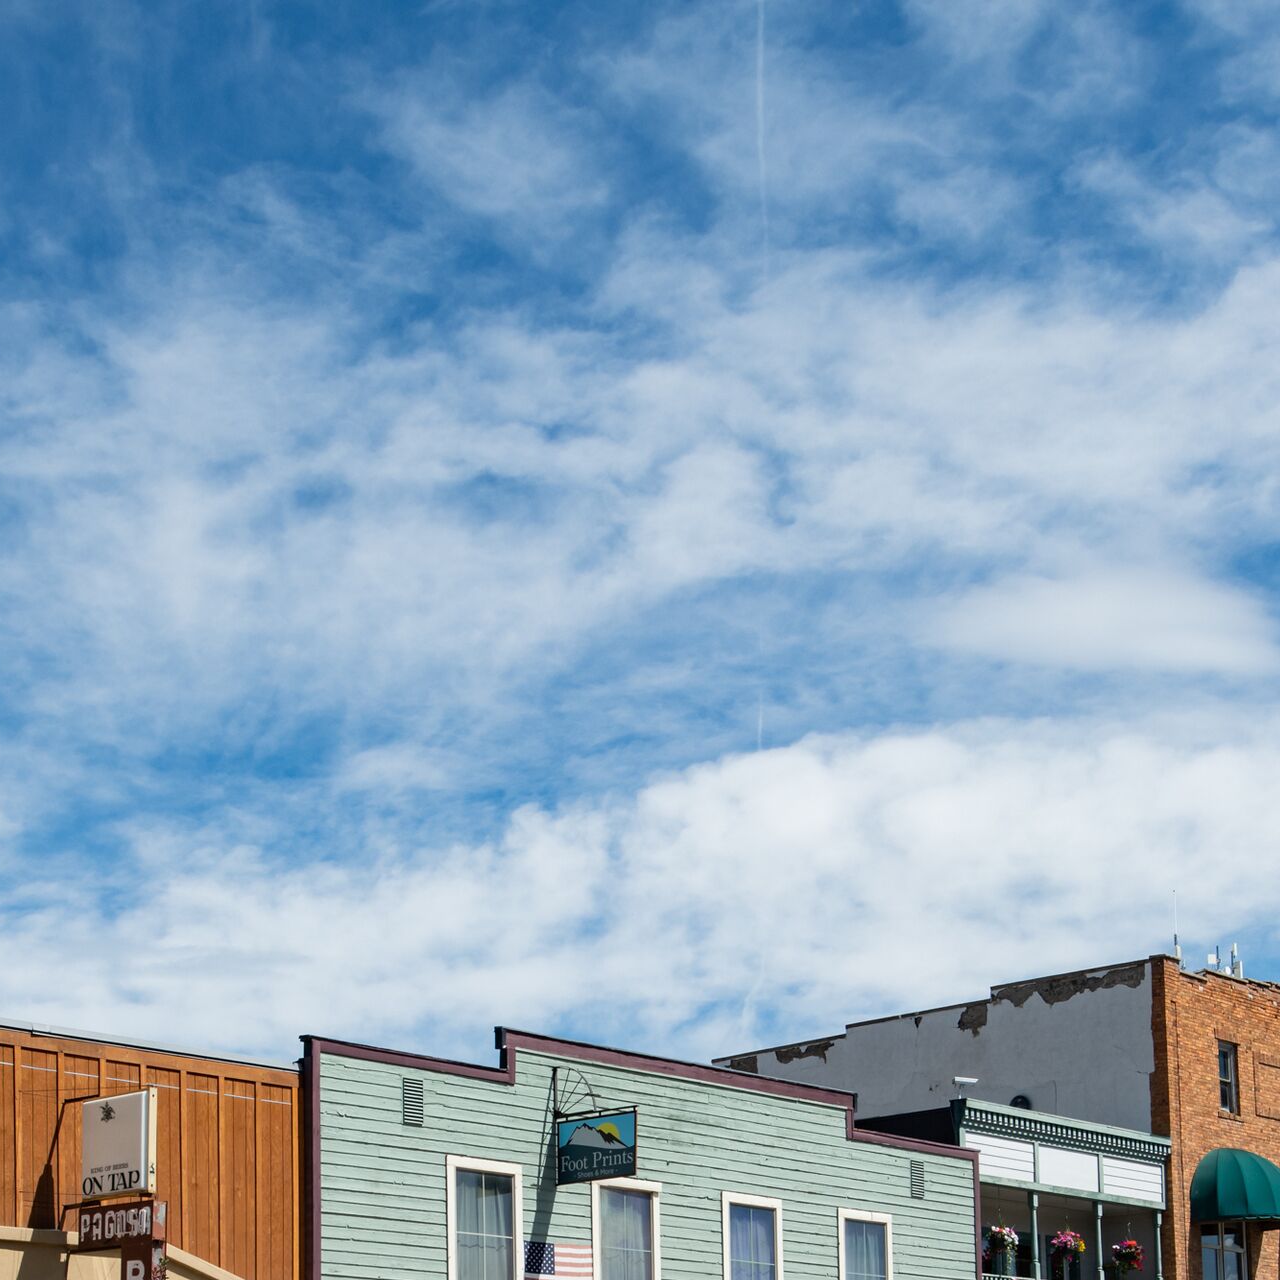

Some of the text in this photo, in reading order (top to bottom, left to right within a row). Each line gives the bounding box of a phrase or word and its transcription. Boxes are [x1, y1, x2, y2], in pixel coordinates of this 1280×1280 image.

[91, 1166, 103, 1174] KING
[561, 1150, 634, 1172] Foot Prints
[82, 1170, 140, 1196] ON TAP
[577, 1170, 593, 1178] Shoes
[600, 1168, 615, 1176] More
[80, 1206, 152, 1242] PAGOSA
